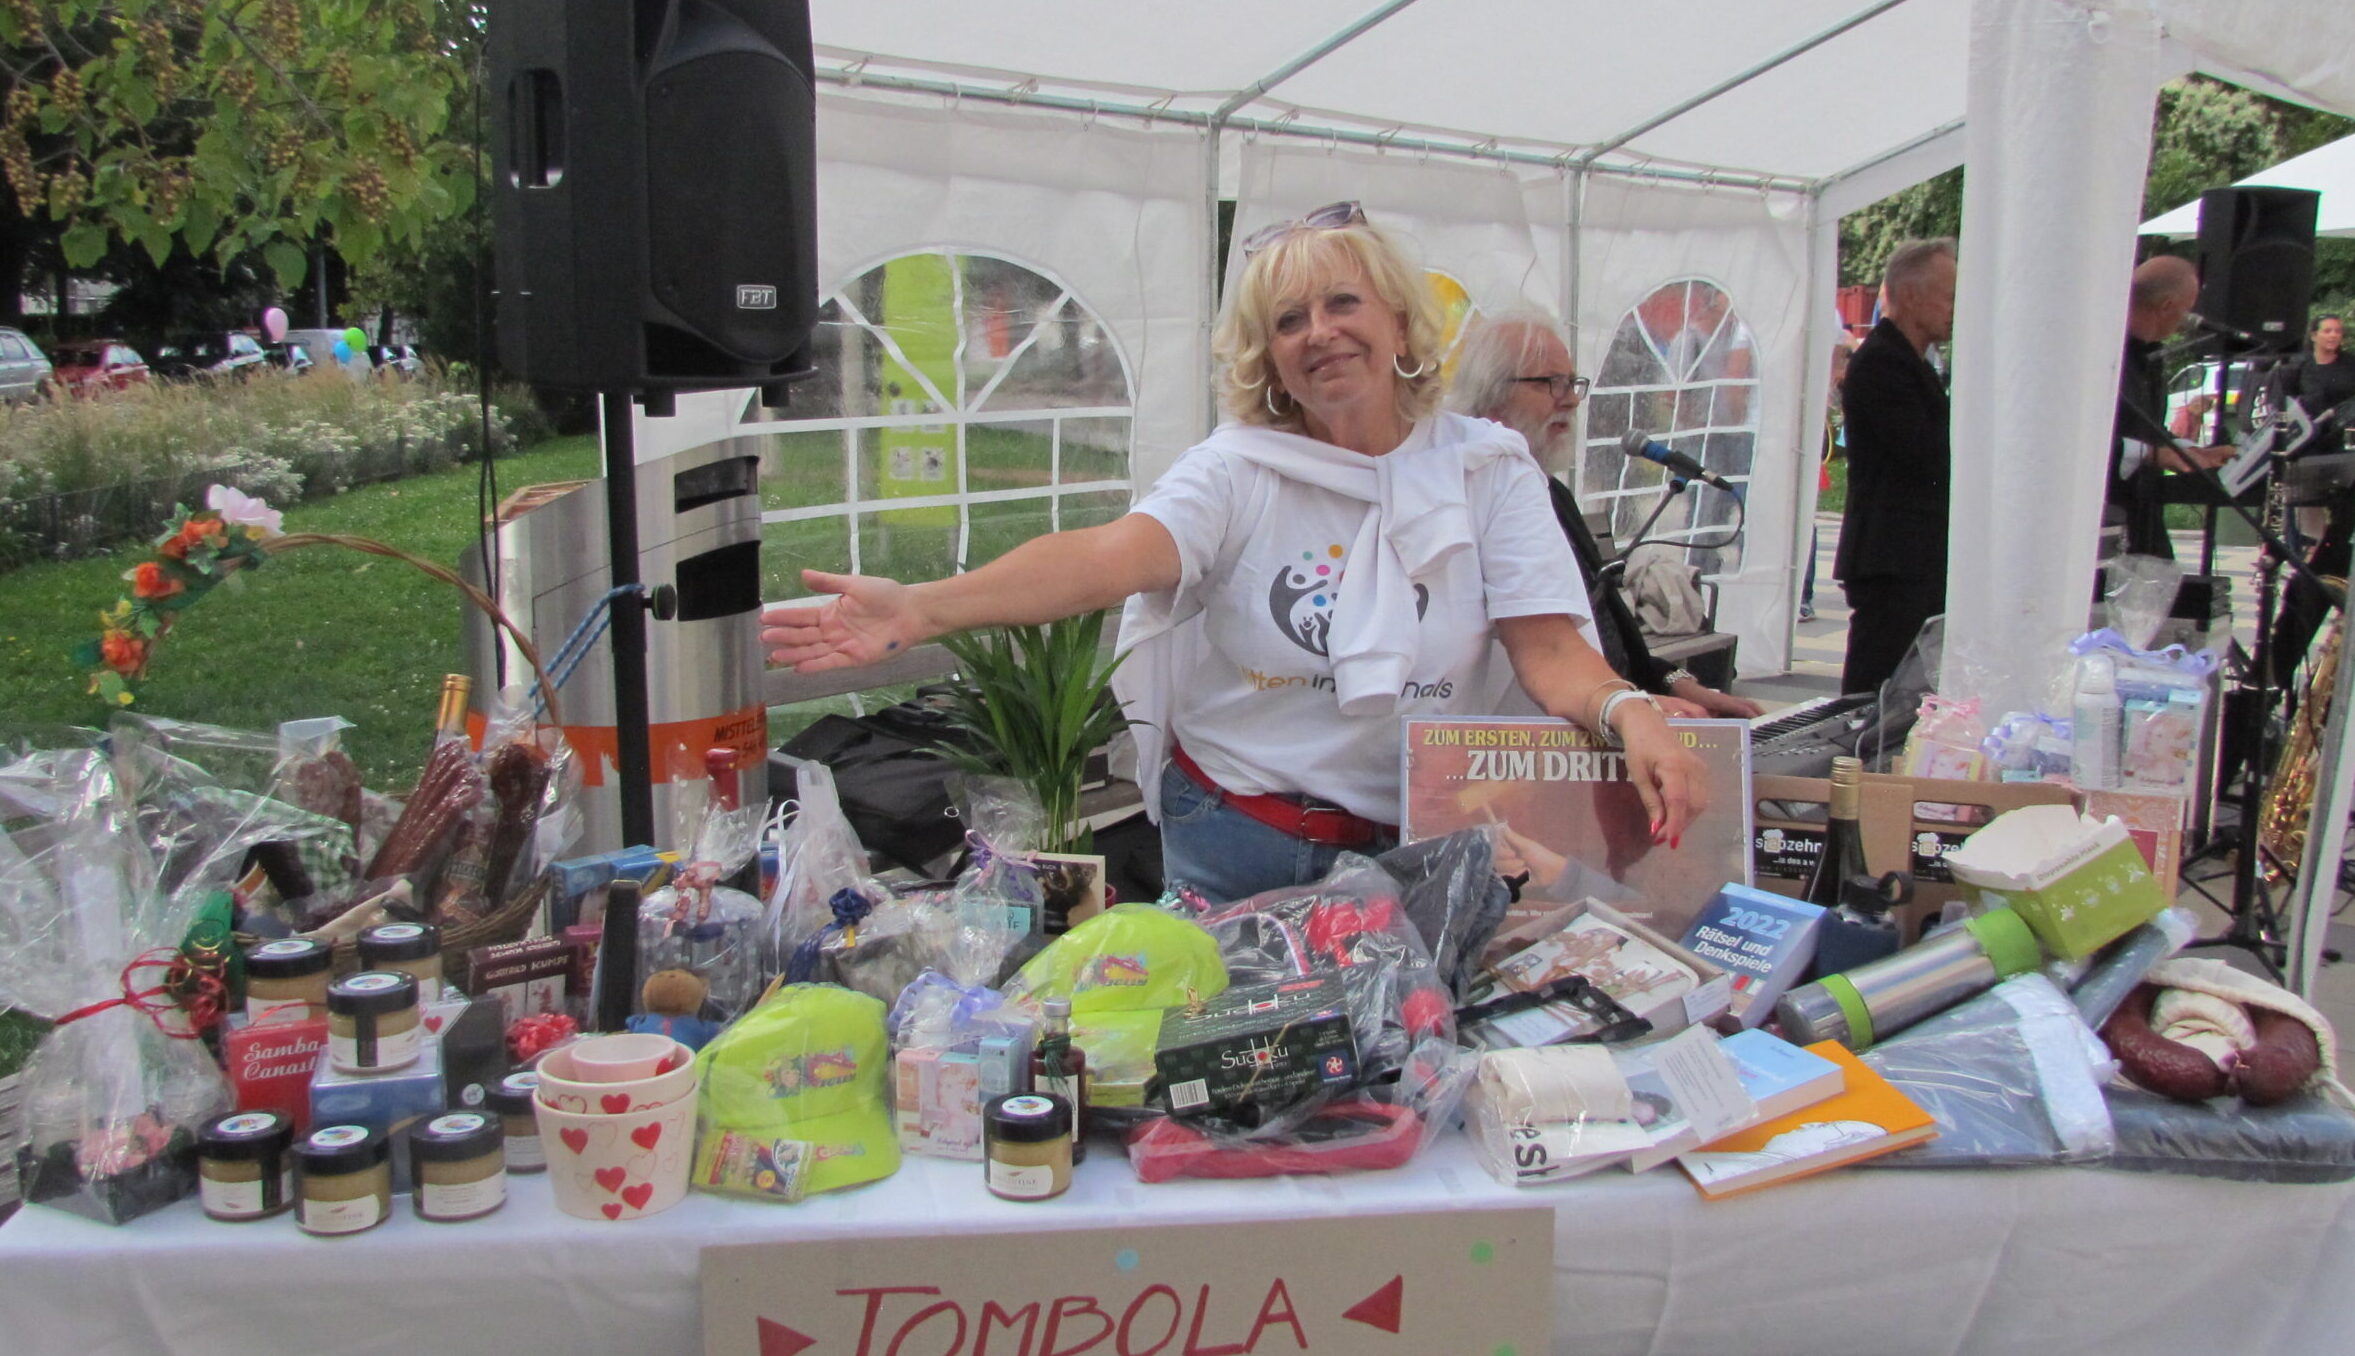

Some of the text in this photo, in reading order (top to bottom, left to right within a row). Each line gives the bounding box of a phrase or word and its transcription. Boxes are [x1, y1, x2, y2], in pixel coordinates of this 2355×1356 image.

[740, 289, 773, 305] FBT
[1401, 677, 1453, 699] nals
[1424, 729, 1460, 746] ZUM
[1540, 730, 1576, 747] ZUM
[1543, 751, 1633, 782] DRIT
[1719, 906, 1791, 940] 2022
[1695, 925, 1774, 957] Rätsel und
[1693, 940, 1772, 974] Denkspiele
[243, 1036, 319, 1062] Samba
[244, 1056, 316, 1081] Canast
[836, 1277, 1309, 1356] TOMBOLA
